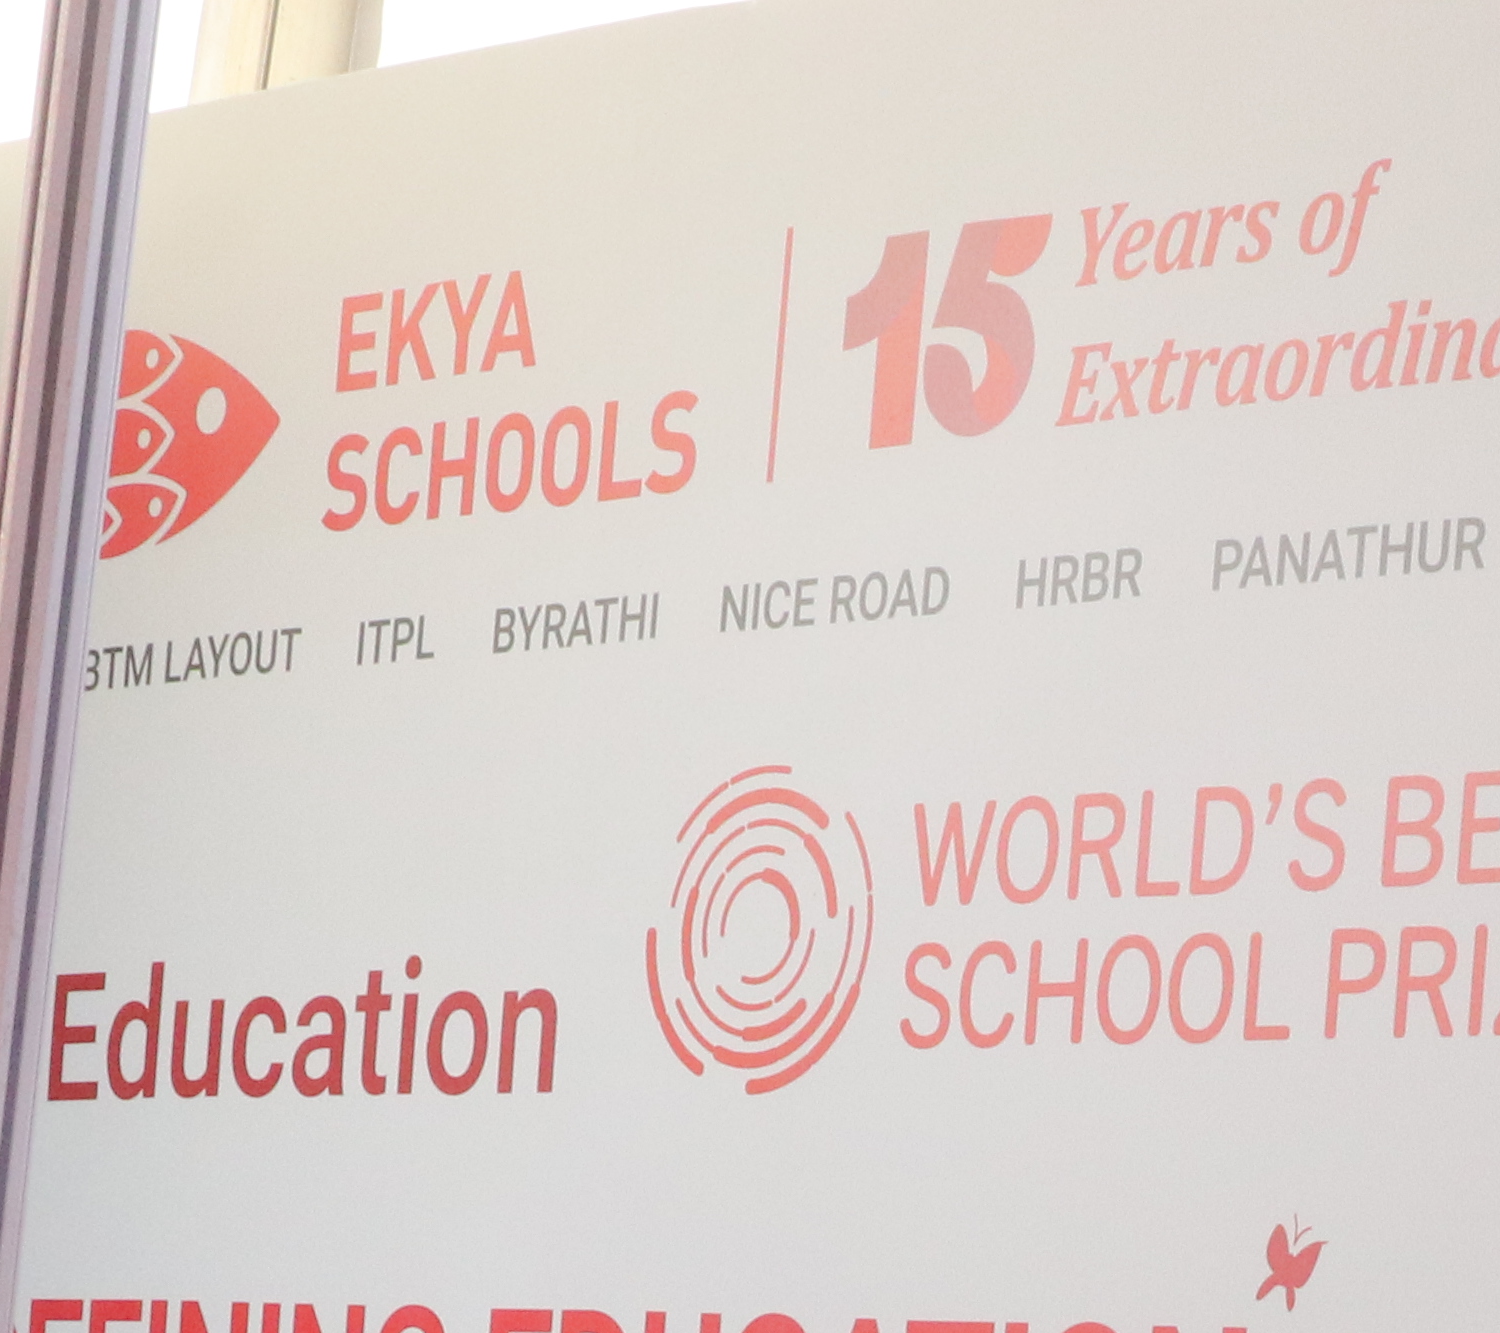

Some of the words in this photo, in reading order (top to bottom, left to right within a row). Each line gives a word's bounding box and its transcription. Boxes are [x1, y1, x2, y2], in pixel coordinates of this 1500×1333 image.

[1077, 201, 1279, 286] Years
[1300, 158, 1392, 276] of
[337, 271, 535, 392] EKYA
[846, 215, 1051, 448] 15
[323, 391, 697, 531] SCHOOLS
[720, 579, 817, 632] NICE
[830, 567, 949, 623] ROAD
[1016, 548, 1142, 608] HRBR
[1213, 517, 1486, 590] PANATHUR
[165, 628, 302, 683] LAYOUT
[357, 616, 434, 665] ITPL
[493, 594, 658, 653] BYRATHI
[48, 956, 556, 1100] Education
[901, 933, 1290, 1049] SCHOOL
